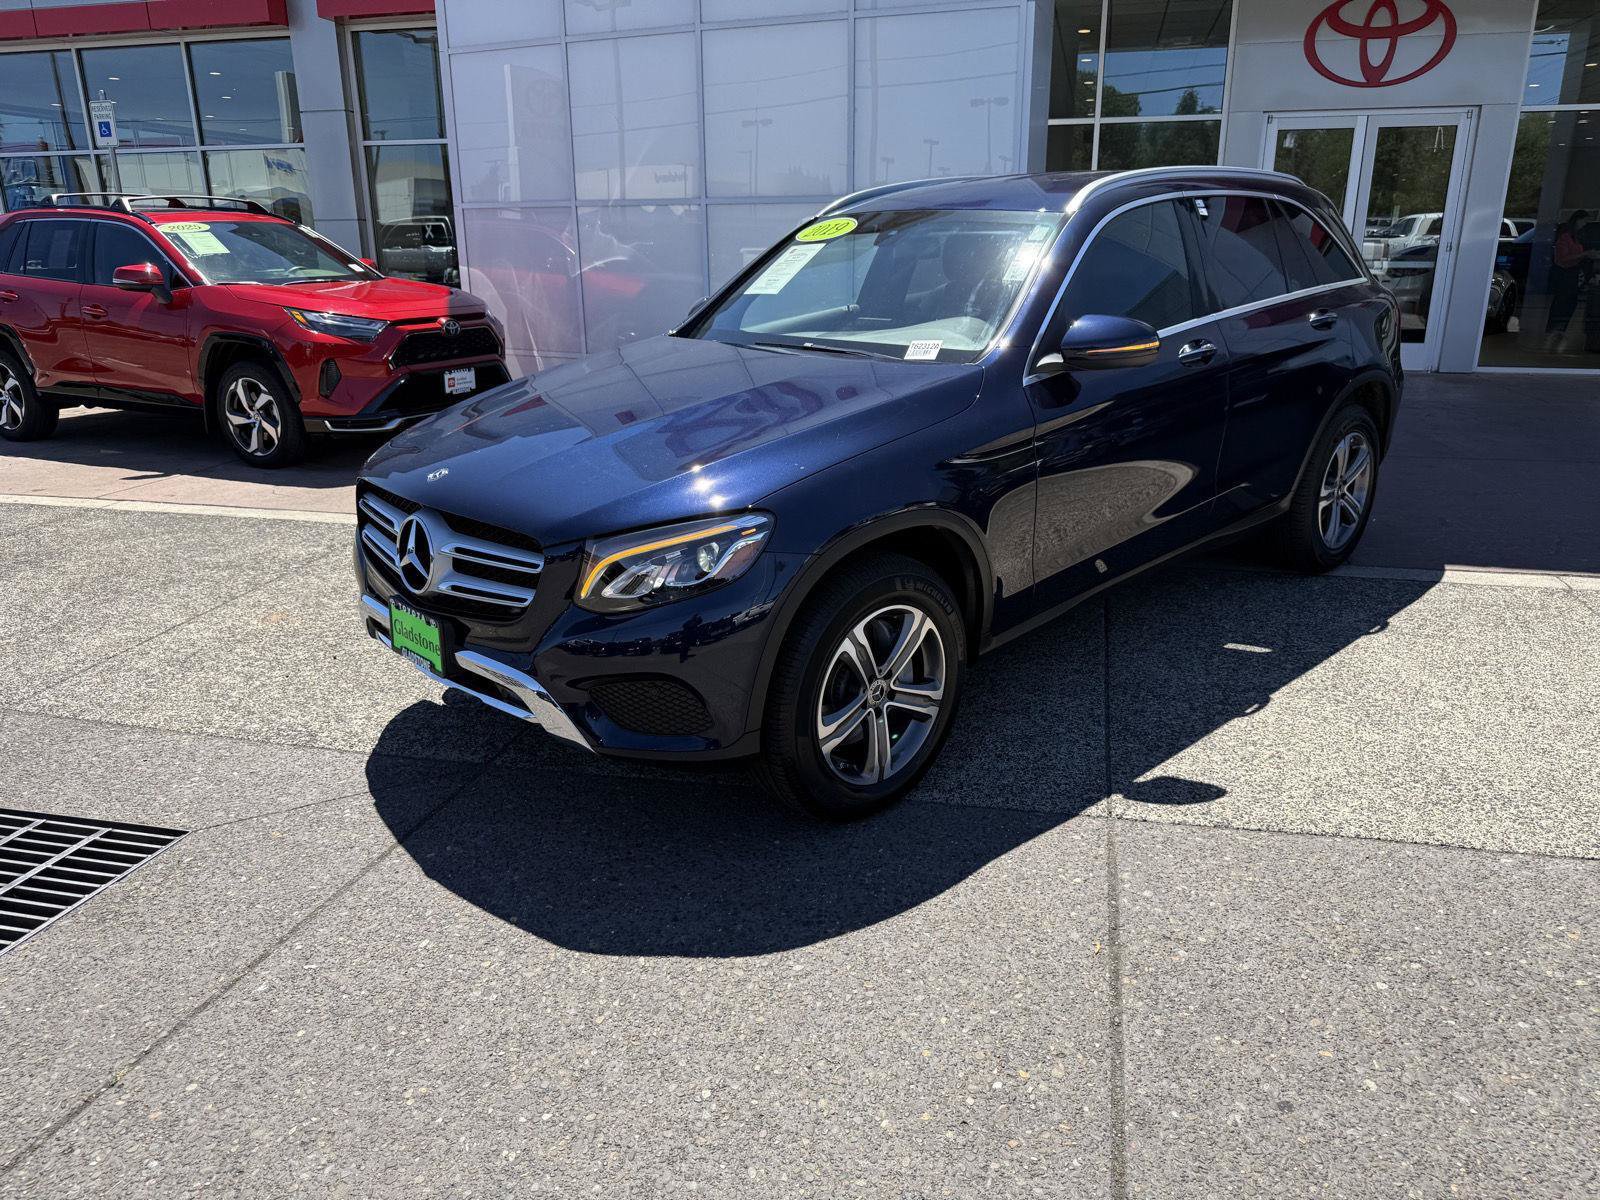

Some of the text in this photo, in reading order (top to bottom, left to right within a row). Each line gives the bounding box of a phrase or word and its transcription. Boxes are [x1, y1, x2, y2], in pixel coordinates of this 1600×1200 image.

[802, 221, 850, 238] 2019
[398, 603, 426, 621] TOYOTA
[394, 619, 441, 656] Gladstone
